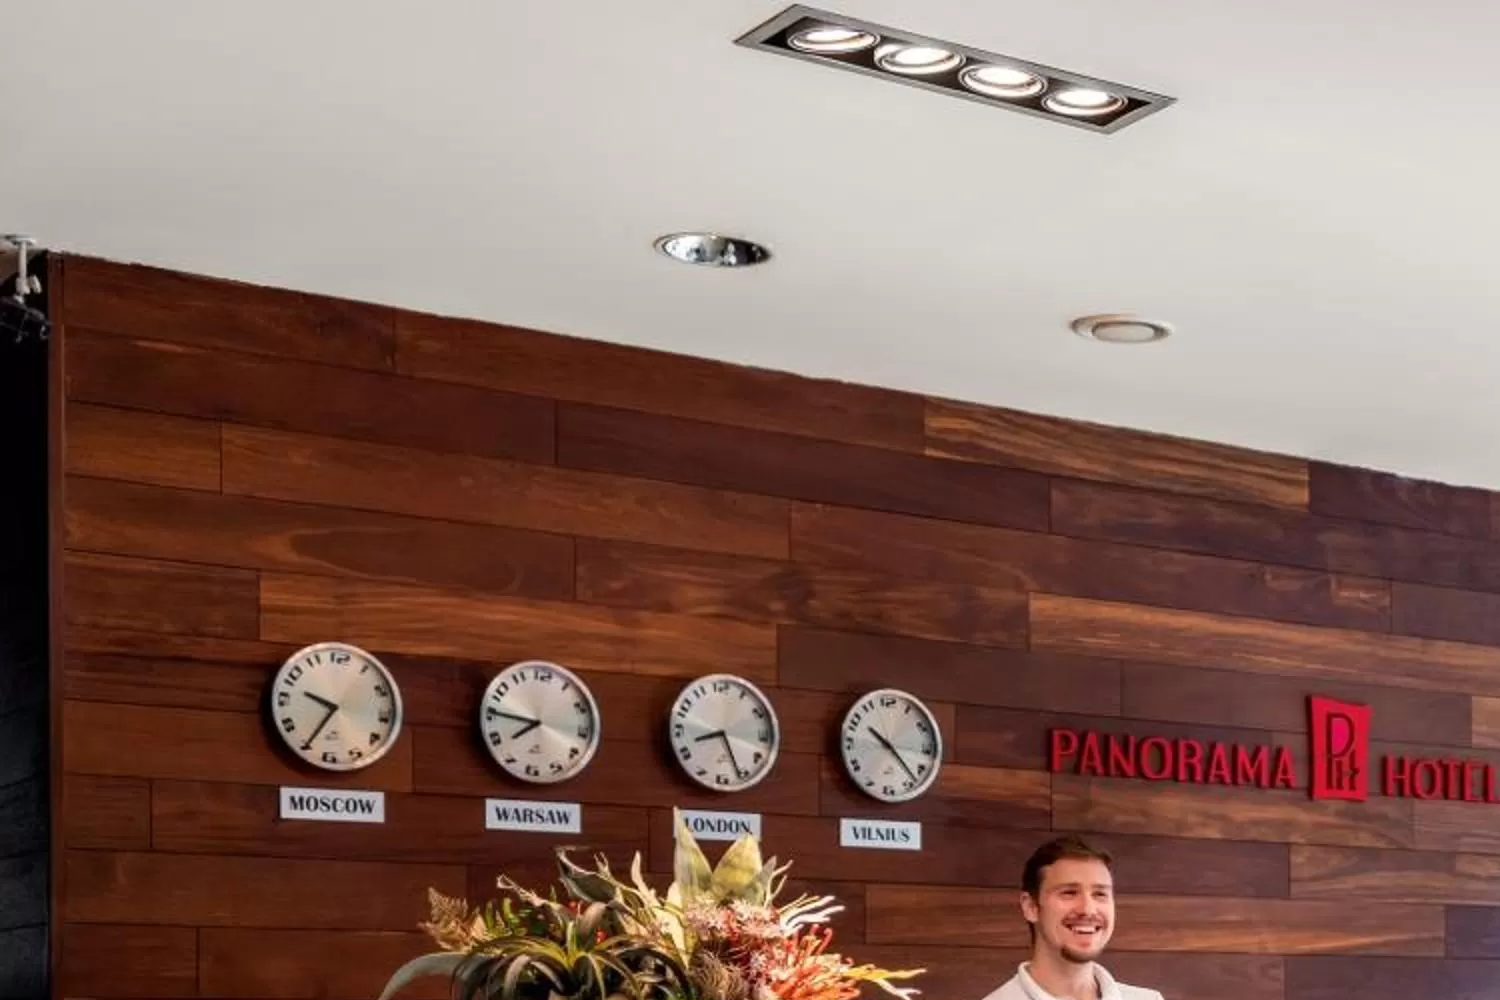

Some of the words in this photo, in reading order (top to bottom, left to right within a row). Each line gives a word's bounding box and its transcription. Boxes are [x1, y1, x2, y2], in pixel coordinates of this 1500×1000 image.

[306, 654, 321, 668] 11
[330, 652, 351, 664] 12
[284, 665, 303, 687] 10
[512, 671, 526, 684] 11
[533, 669, 552, 682] 12
[492, 681, 509, 702] 10
[693, 685, 706, 698] 11
[713, 682, 729, 693] 12
[677, 697, 692, 718] 10
[1050, 727, 1297, 790] PANORAMA
[289, 795, 377, 815] MOSCOW
[495, 806, 573, 826] WARSAW
[684, 817, 753, 835] LONDON
[852, 826, 911, 842] VILNIUS
